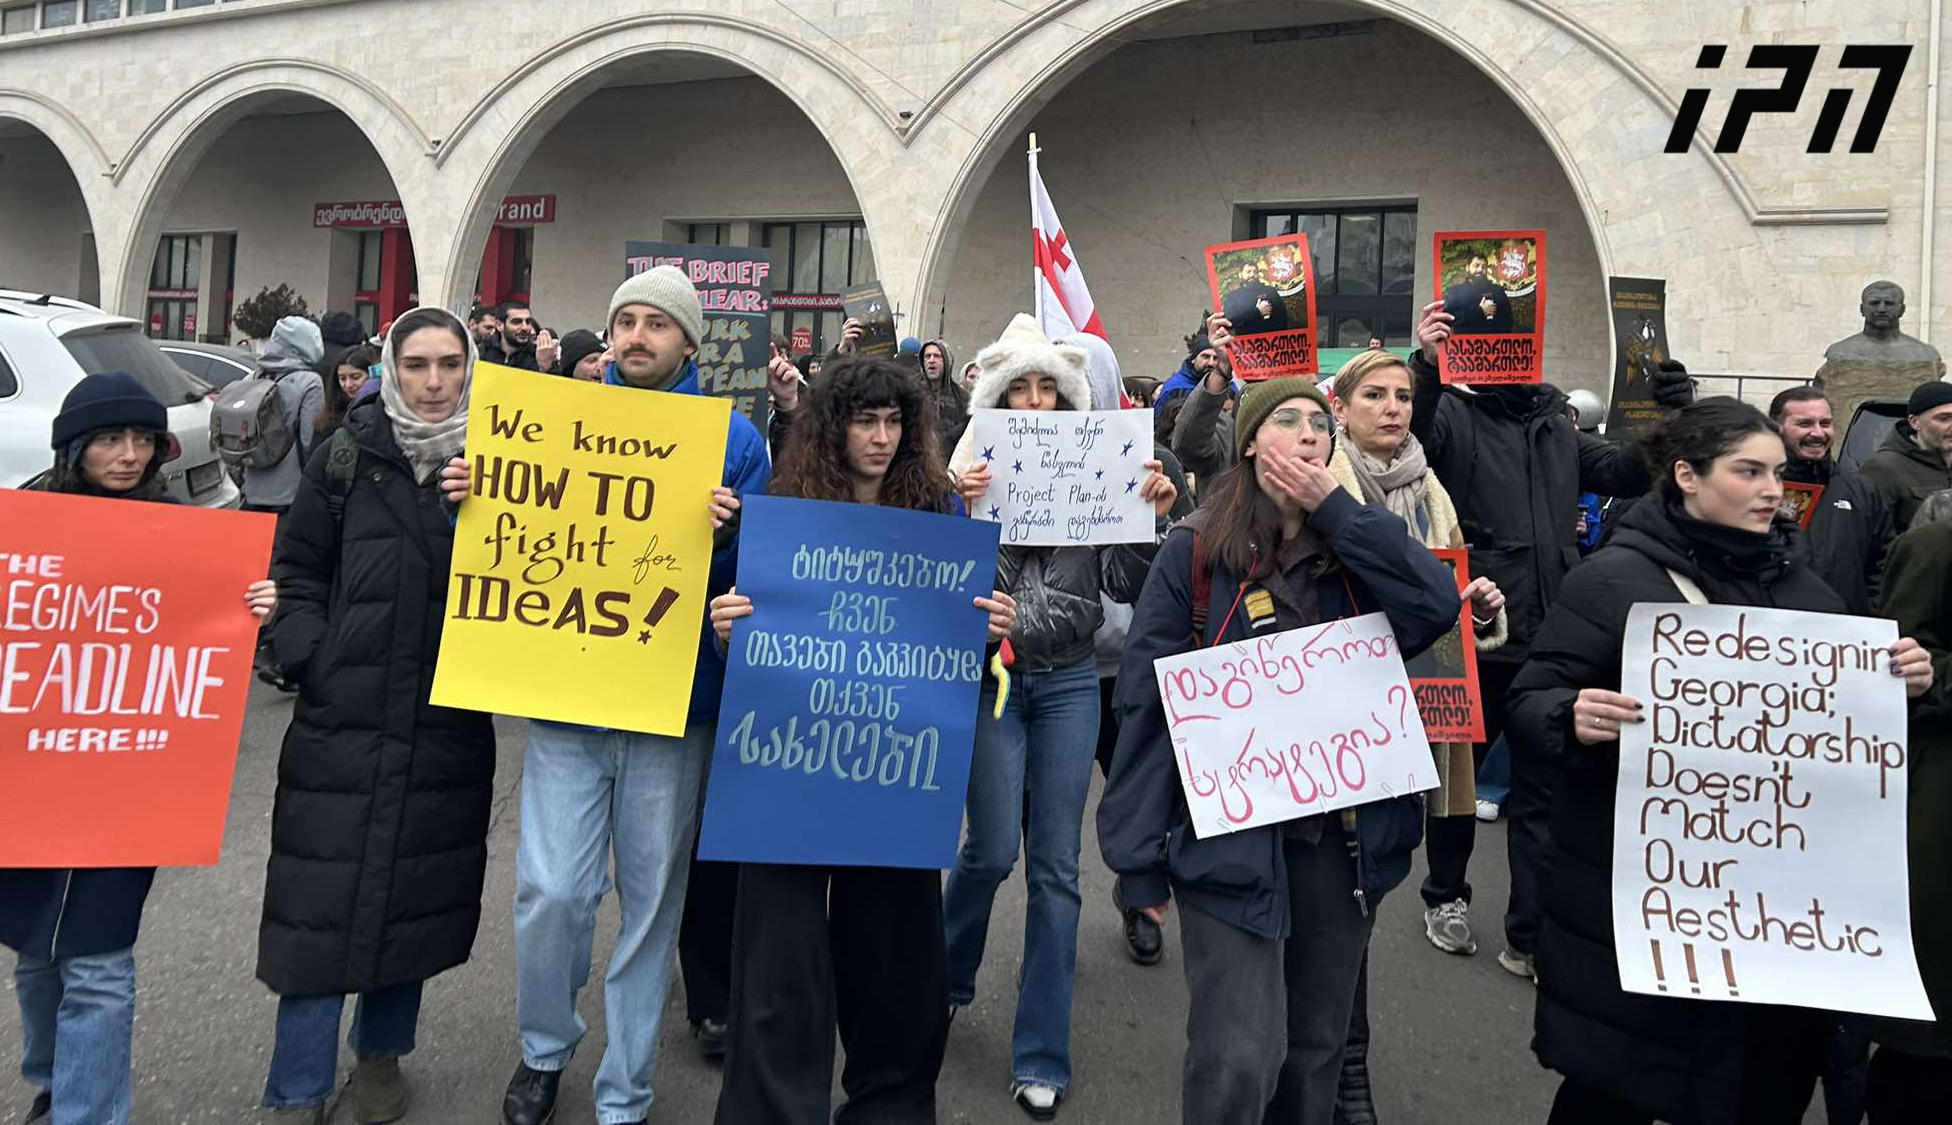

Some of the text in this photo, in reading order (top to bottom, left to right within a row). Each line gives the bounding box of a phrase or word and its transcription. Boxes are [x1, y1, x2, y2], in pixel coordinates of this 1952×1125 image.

[688, 259, 770, 287] BRIEF
[484, 404, 678, 460] We know
[473, 454, 656, 522] HOW TO
[1007, 482, 1056, 507] Project
[484, 512, 682, 586] fight for
[0, 580, 161, 635] EGIME'S
[746, 629, 846, 673] თავები
[0, 642, 230, 720] EADLINE
[809, 677, 906, 721] თქვენ
[1650, 657, 1836, 727] Georgia;
[28, 728, 169, 752] HERE!!!
[1652, 702, 1905, 799] Dictatorship
[1646, 747, 1811, 808] Doesn't
[1640, 797, 1806, 852] Match
[1645, 838, 1739, 889] Our
[1642, 886, 1884, 957] Aesthetic
